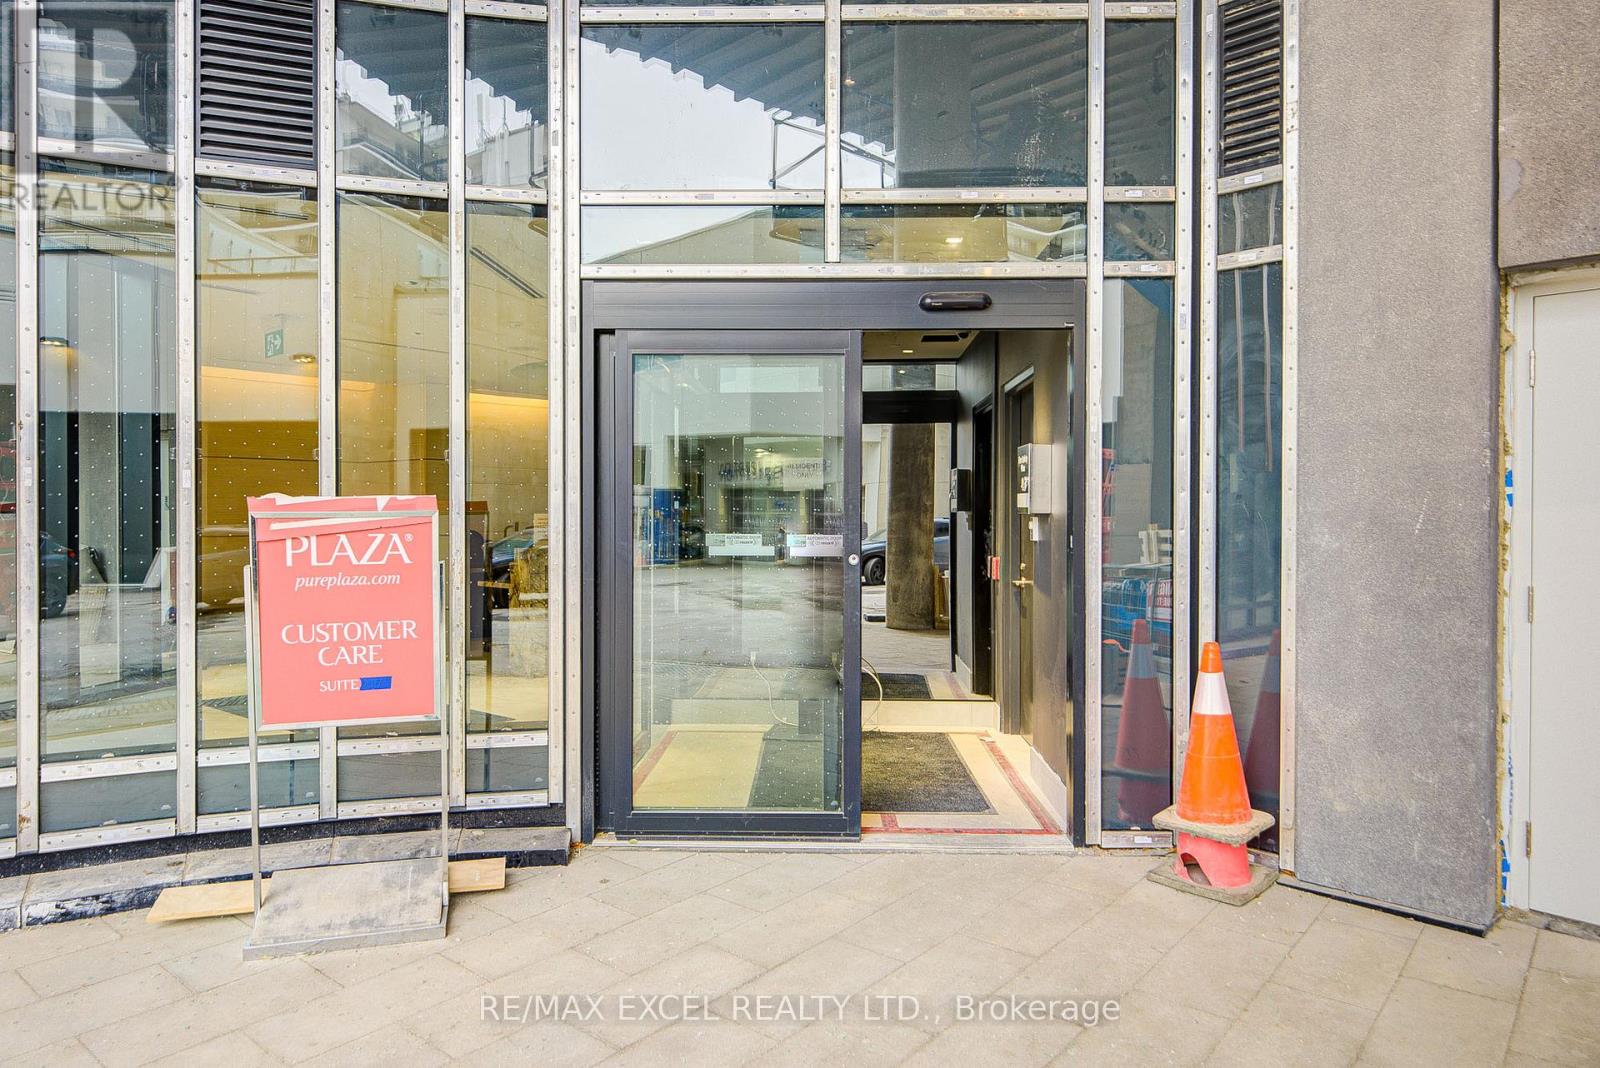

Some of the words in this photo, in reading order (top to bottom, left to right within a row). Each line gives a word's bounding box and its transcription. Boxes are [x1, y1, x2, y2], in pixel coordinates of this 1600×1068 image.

[294, 572, 401, 591] pureplaza.com
[281, 620, 418, 645] CUSTOMER
[318, 645, 384, 666] CARE
[319, 679, 360, 692] SUITE
